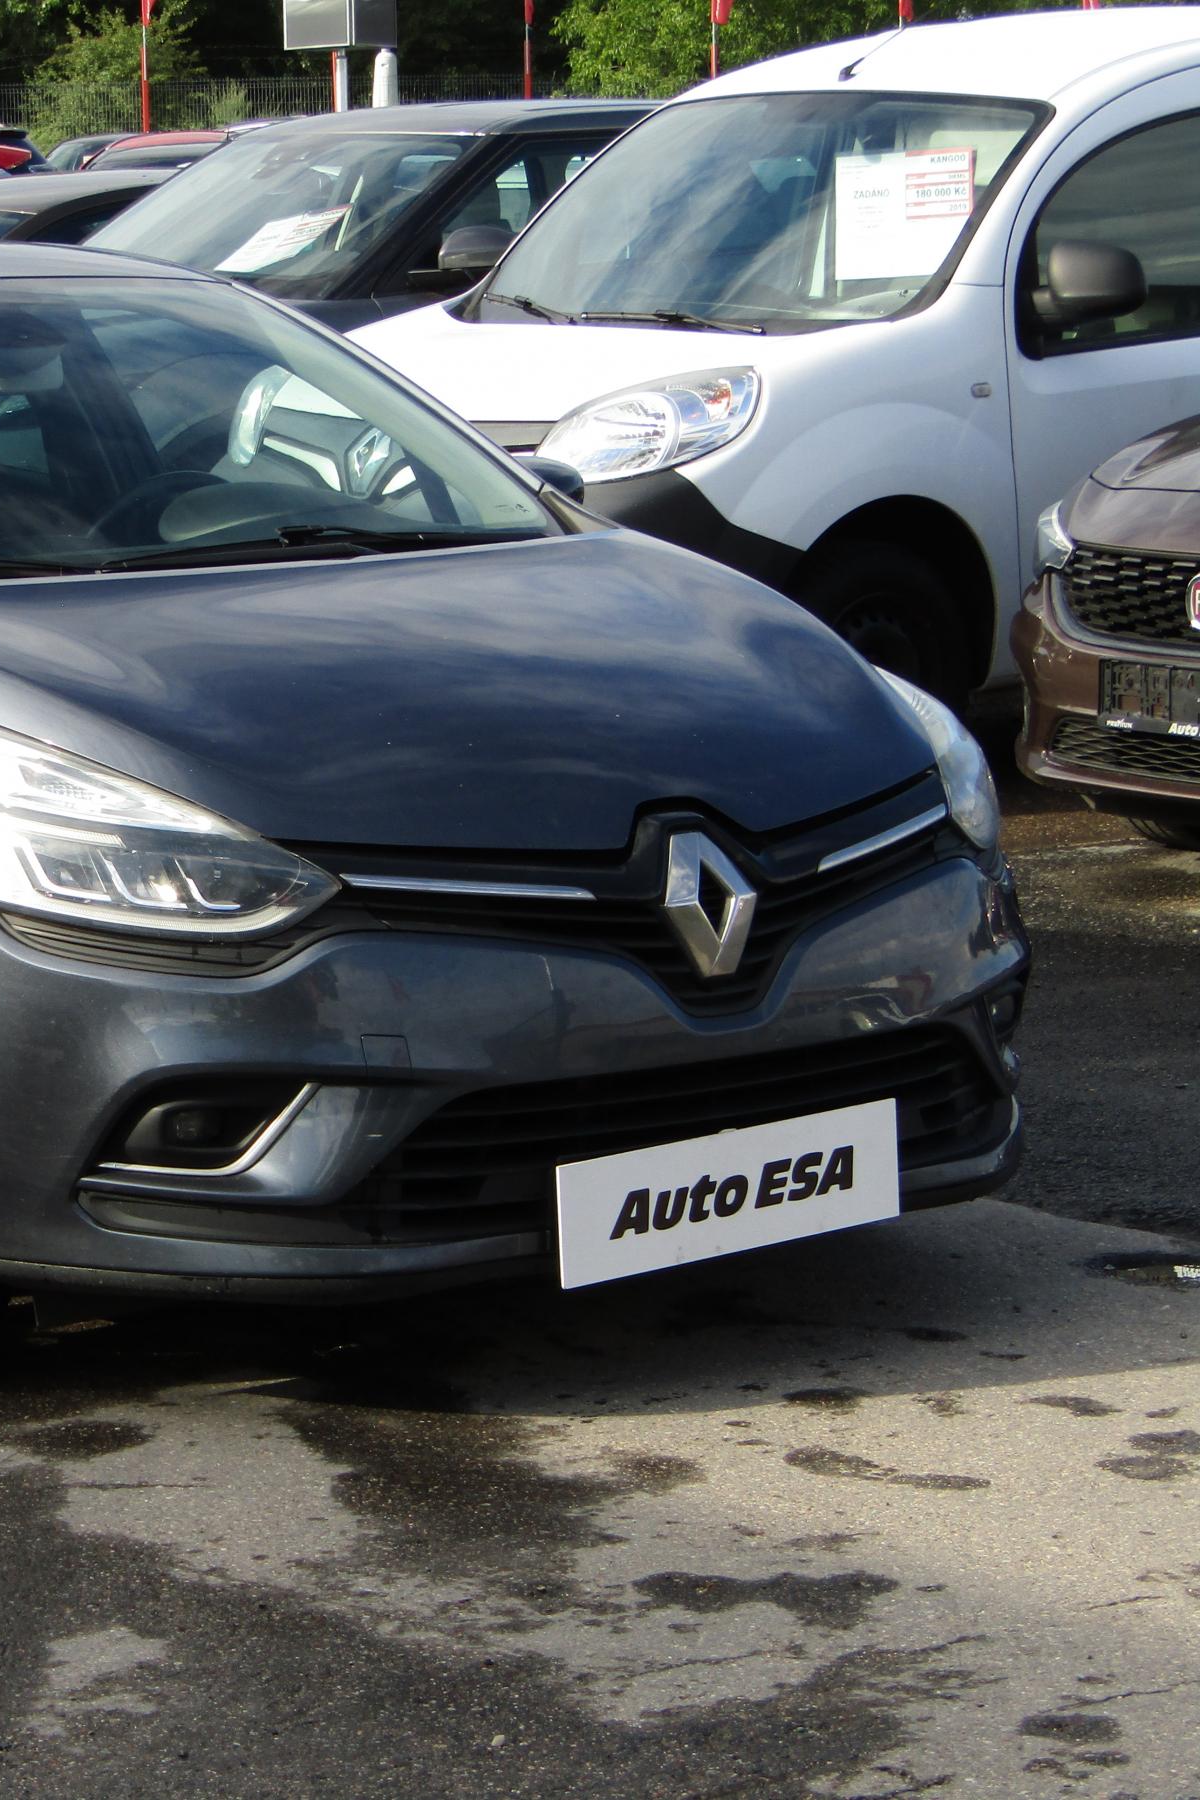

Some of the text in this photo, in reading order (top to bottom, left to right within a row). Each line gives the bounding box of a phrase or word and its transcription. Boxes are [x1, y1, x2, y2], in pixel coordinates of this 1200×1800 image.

[930, 154, 966, 164] KANGOO
[915, 188, 932, 199] 180
[934, 187, 951, 198] 000
[1167, 722, 1199, 737] Auto
[609, 1145, 854, 1241] Auto ESA
